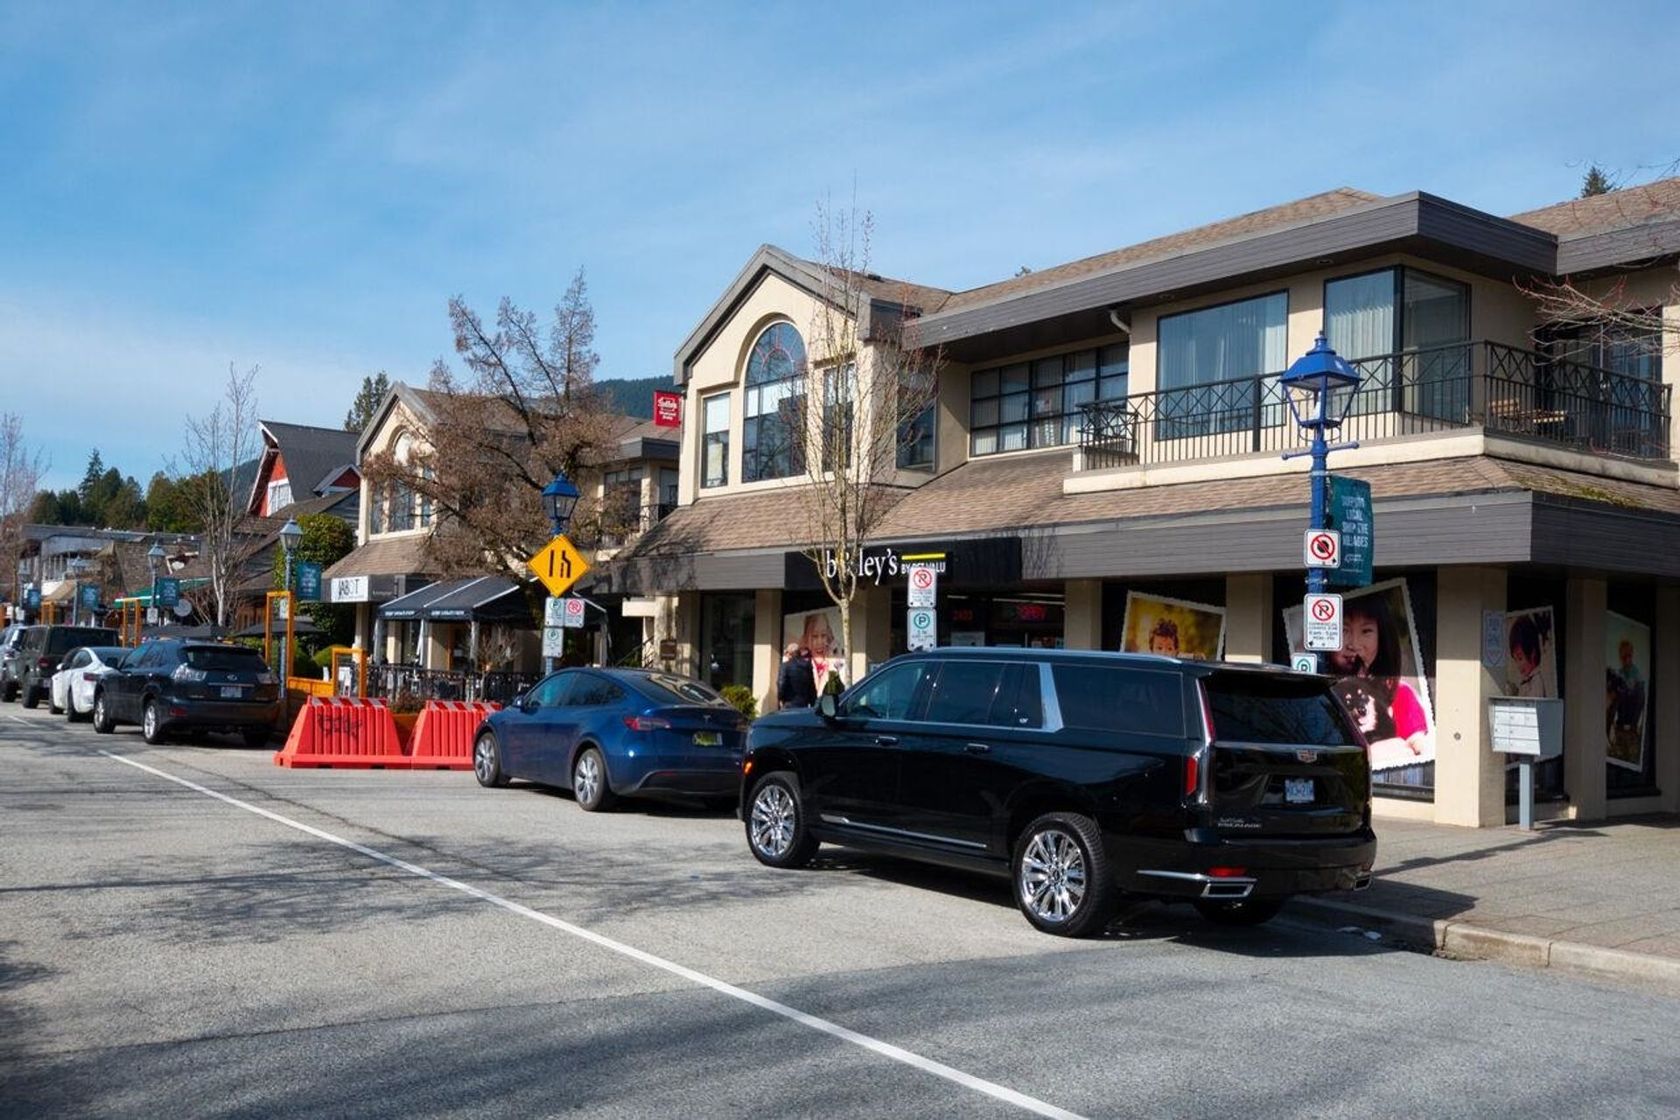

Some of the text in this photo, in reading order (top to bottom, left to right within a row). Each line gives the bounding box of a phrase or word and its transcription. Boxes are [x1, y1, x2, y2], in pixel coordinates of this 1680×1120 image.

[1345, 509, 1363, 521] LOCAL
[1342, 521, 1356, 534] SHOP
[1342, 534, 1369, 547] VILLAGES
[826, 548, 898, 586] bley's
